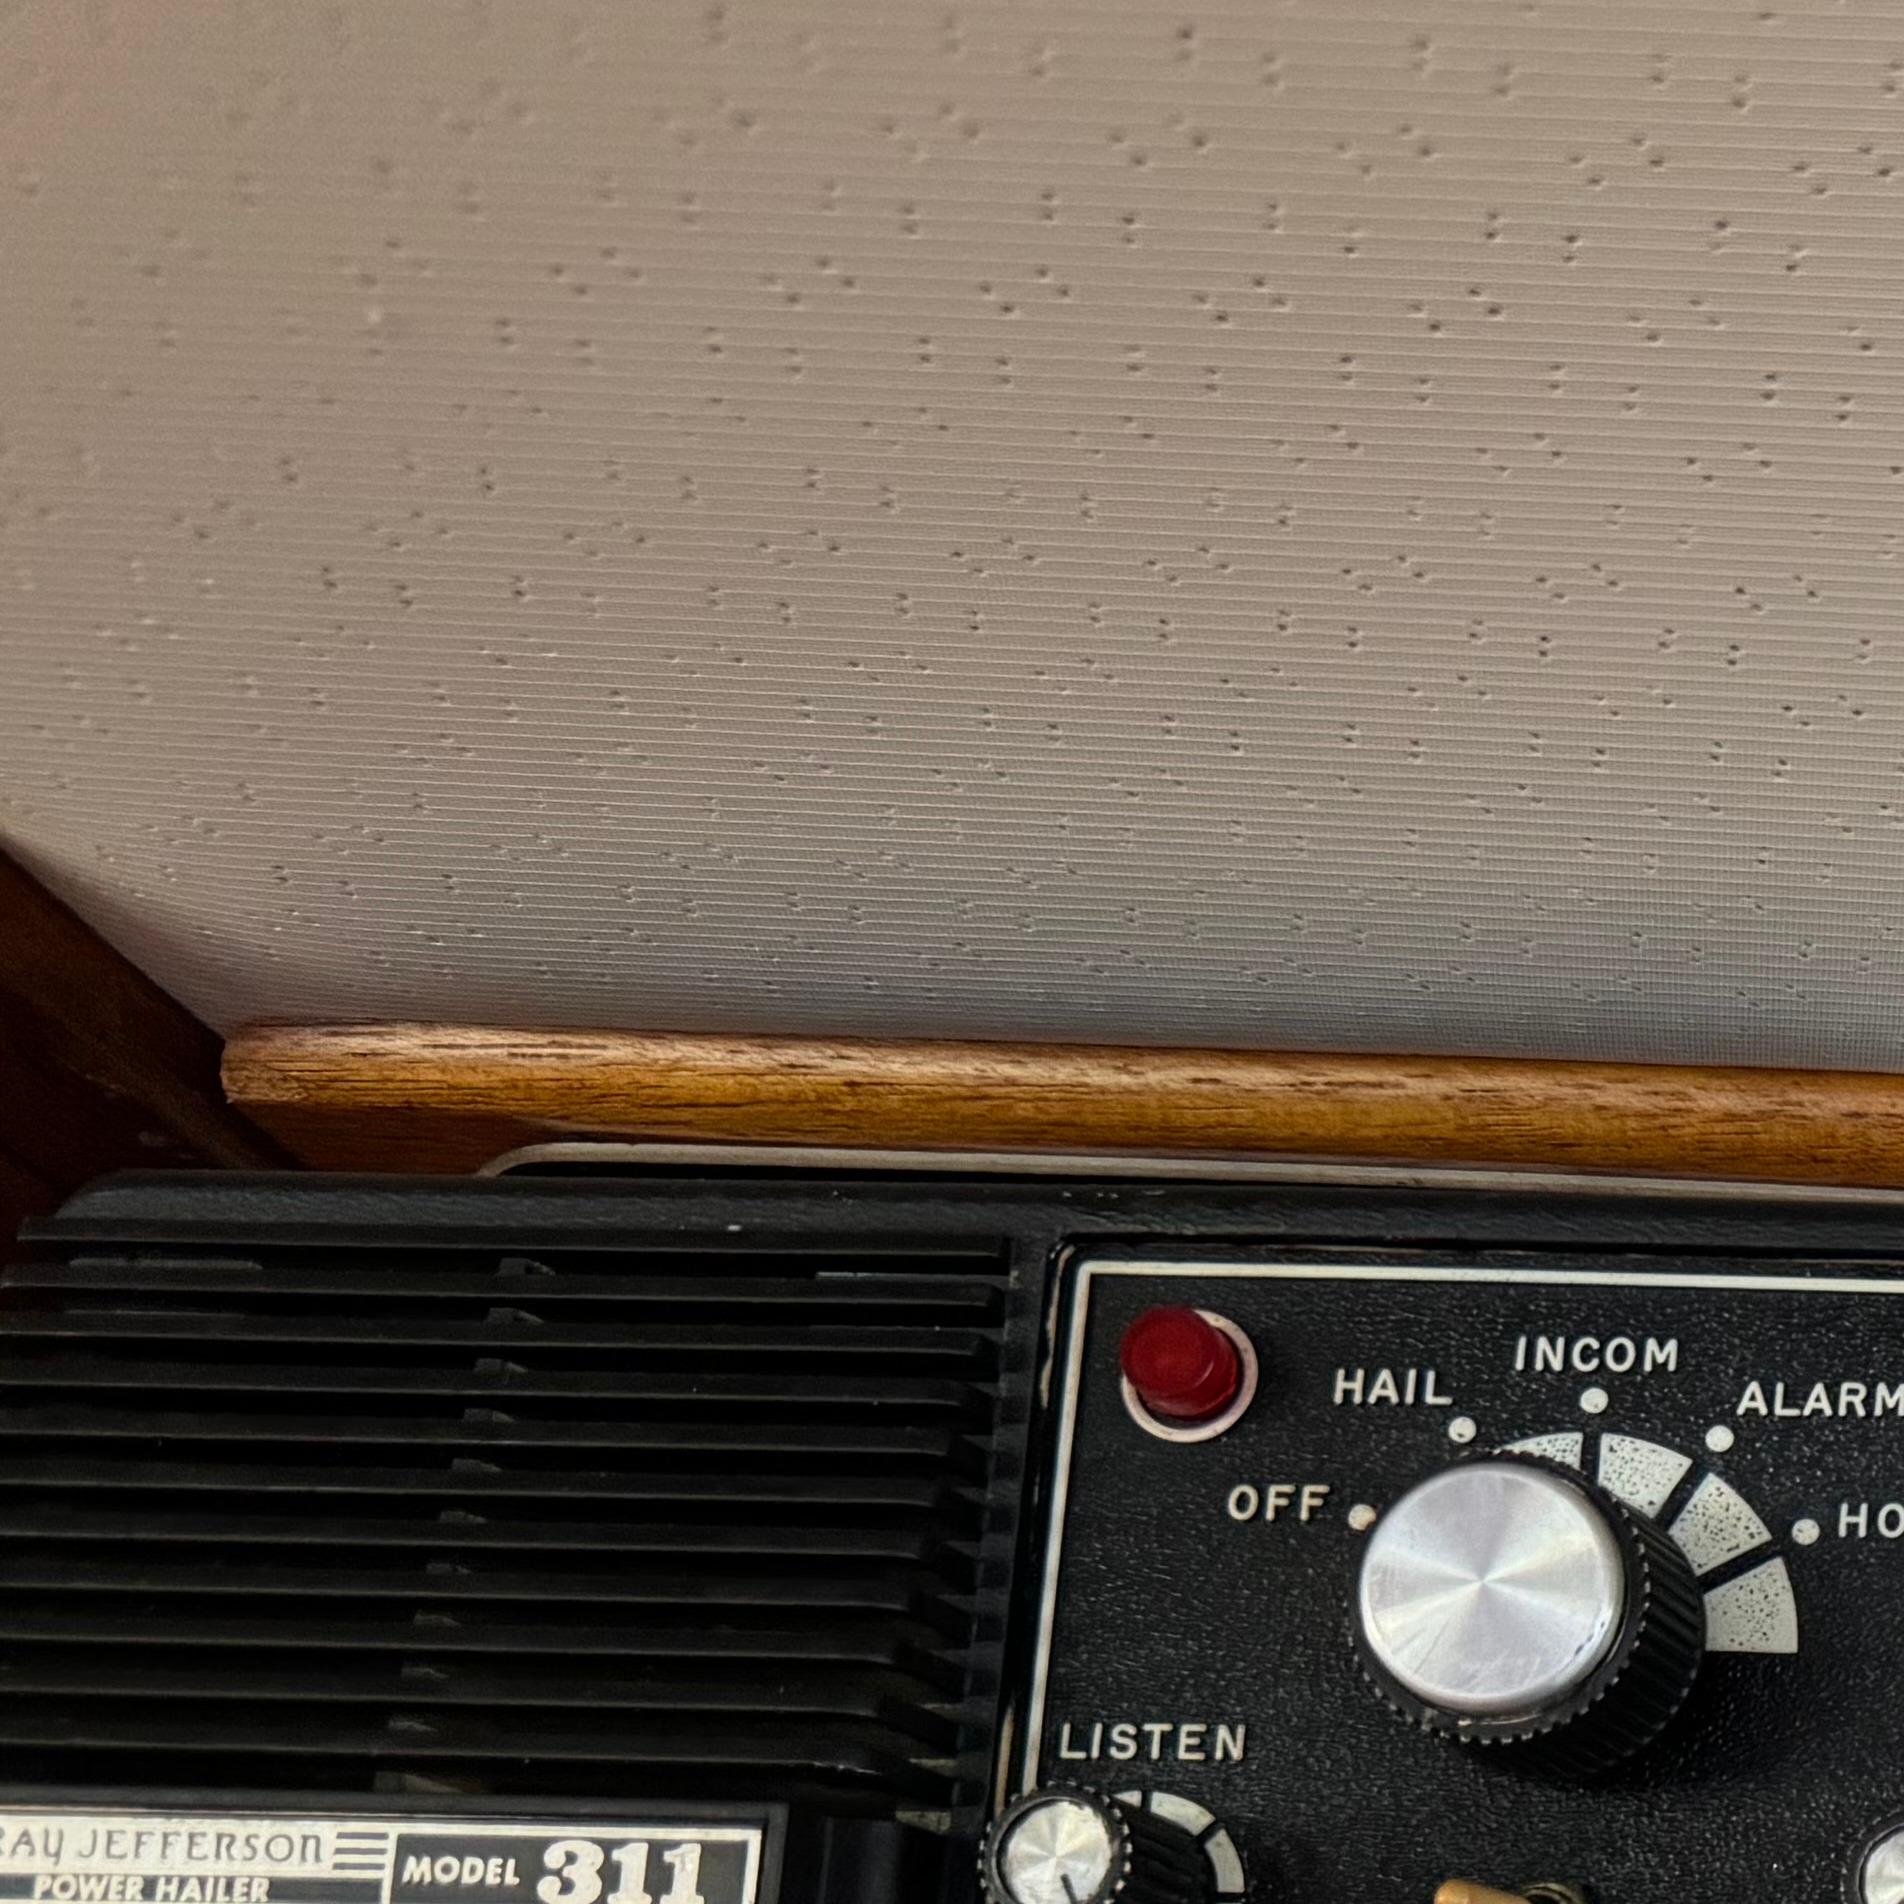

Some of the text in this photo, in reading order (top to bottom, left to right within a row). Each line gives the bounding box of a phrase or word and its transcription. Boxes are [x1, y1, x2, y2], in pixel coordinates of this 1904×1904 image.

[1513, 1335, 1680, 1373] INCOM
[1333, 1368, 1454, 1406] HAIL
[1227, 1483, 1331, 1522] OFF
[1059, 1722, 1247, 1761] LISTEN
[0, 1826, 323, 1866] AY JEFFERSON
[33, 1874, 271, 1904] POWER HAILER
[401, 1855, 521, 1886] MODEL
